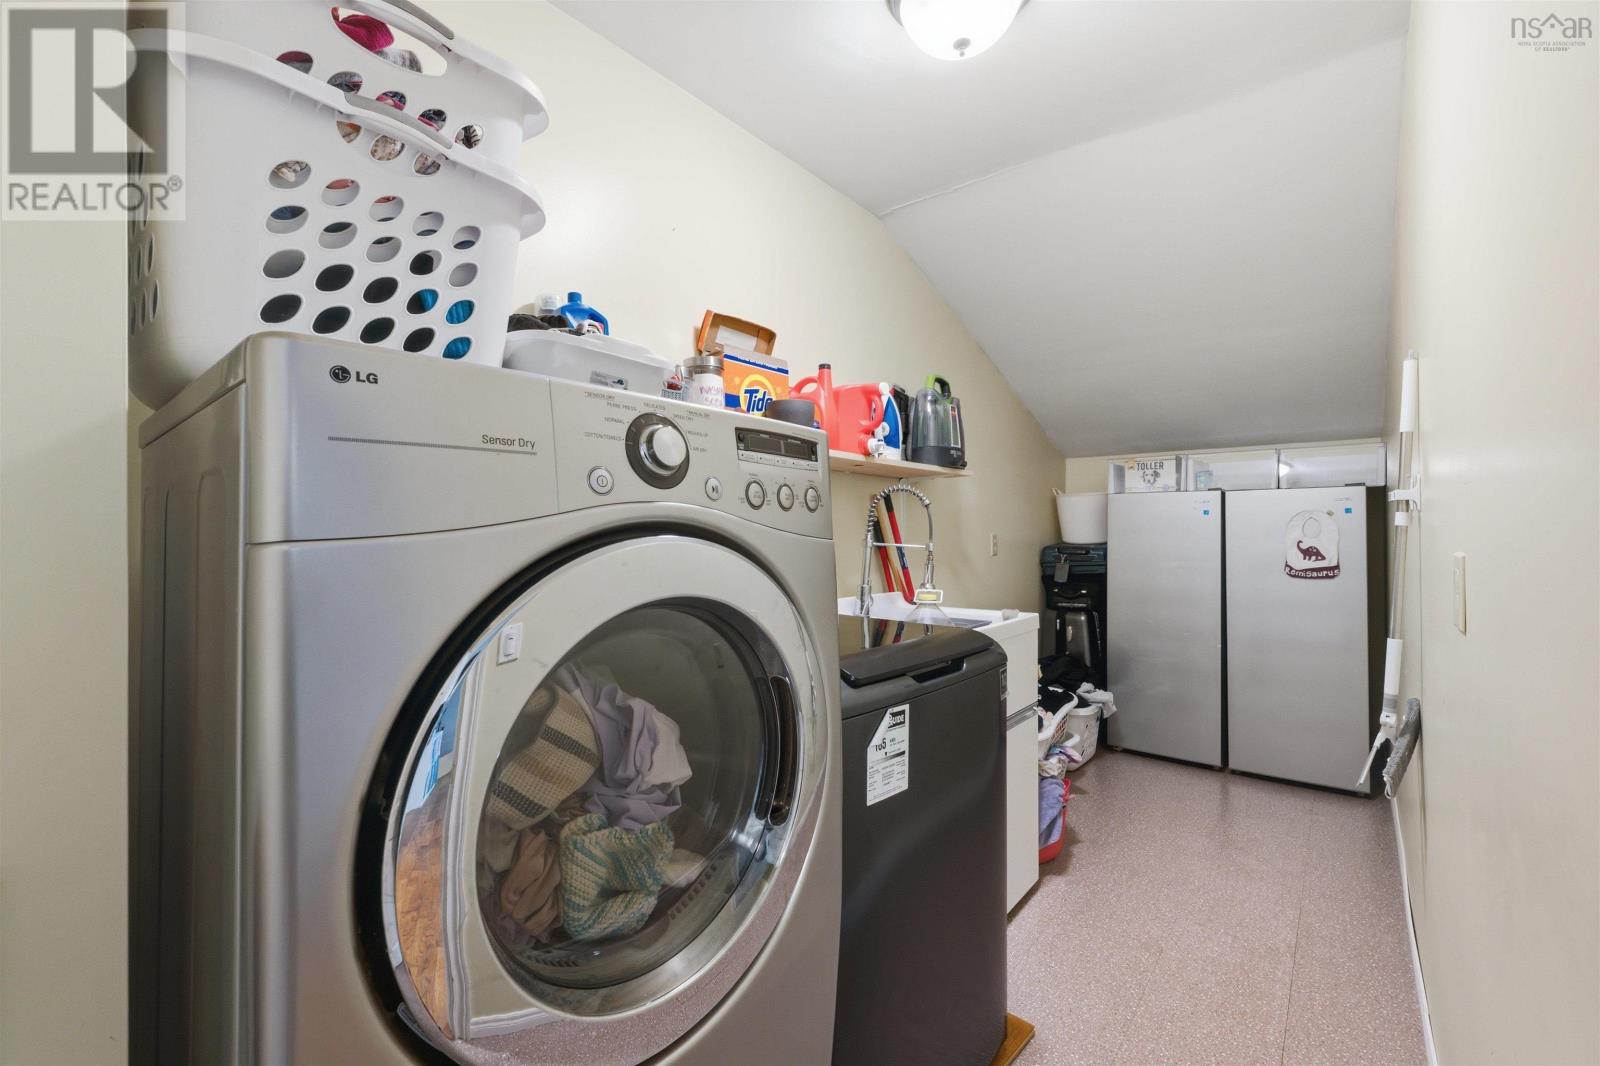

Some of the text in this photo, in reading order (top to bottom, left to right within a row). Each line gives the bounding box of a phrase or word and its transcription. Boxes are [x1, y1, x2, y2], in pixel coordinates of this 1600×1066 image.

[355, 370, 379, 385] LG
[481, 434, 536, 450] Sensor Dry
[1136, 461, 1165, 471] TOLLER
